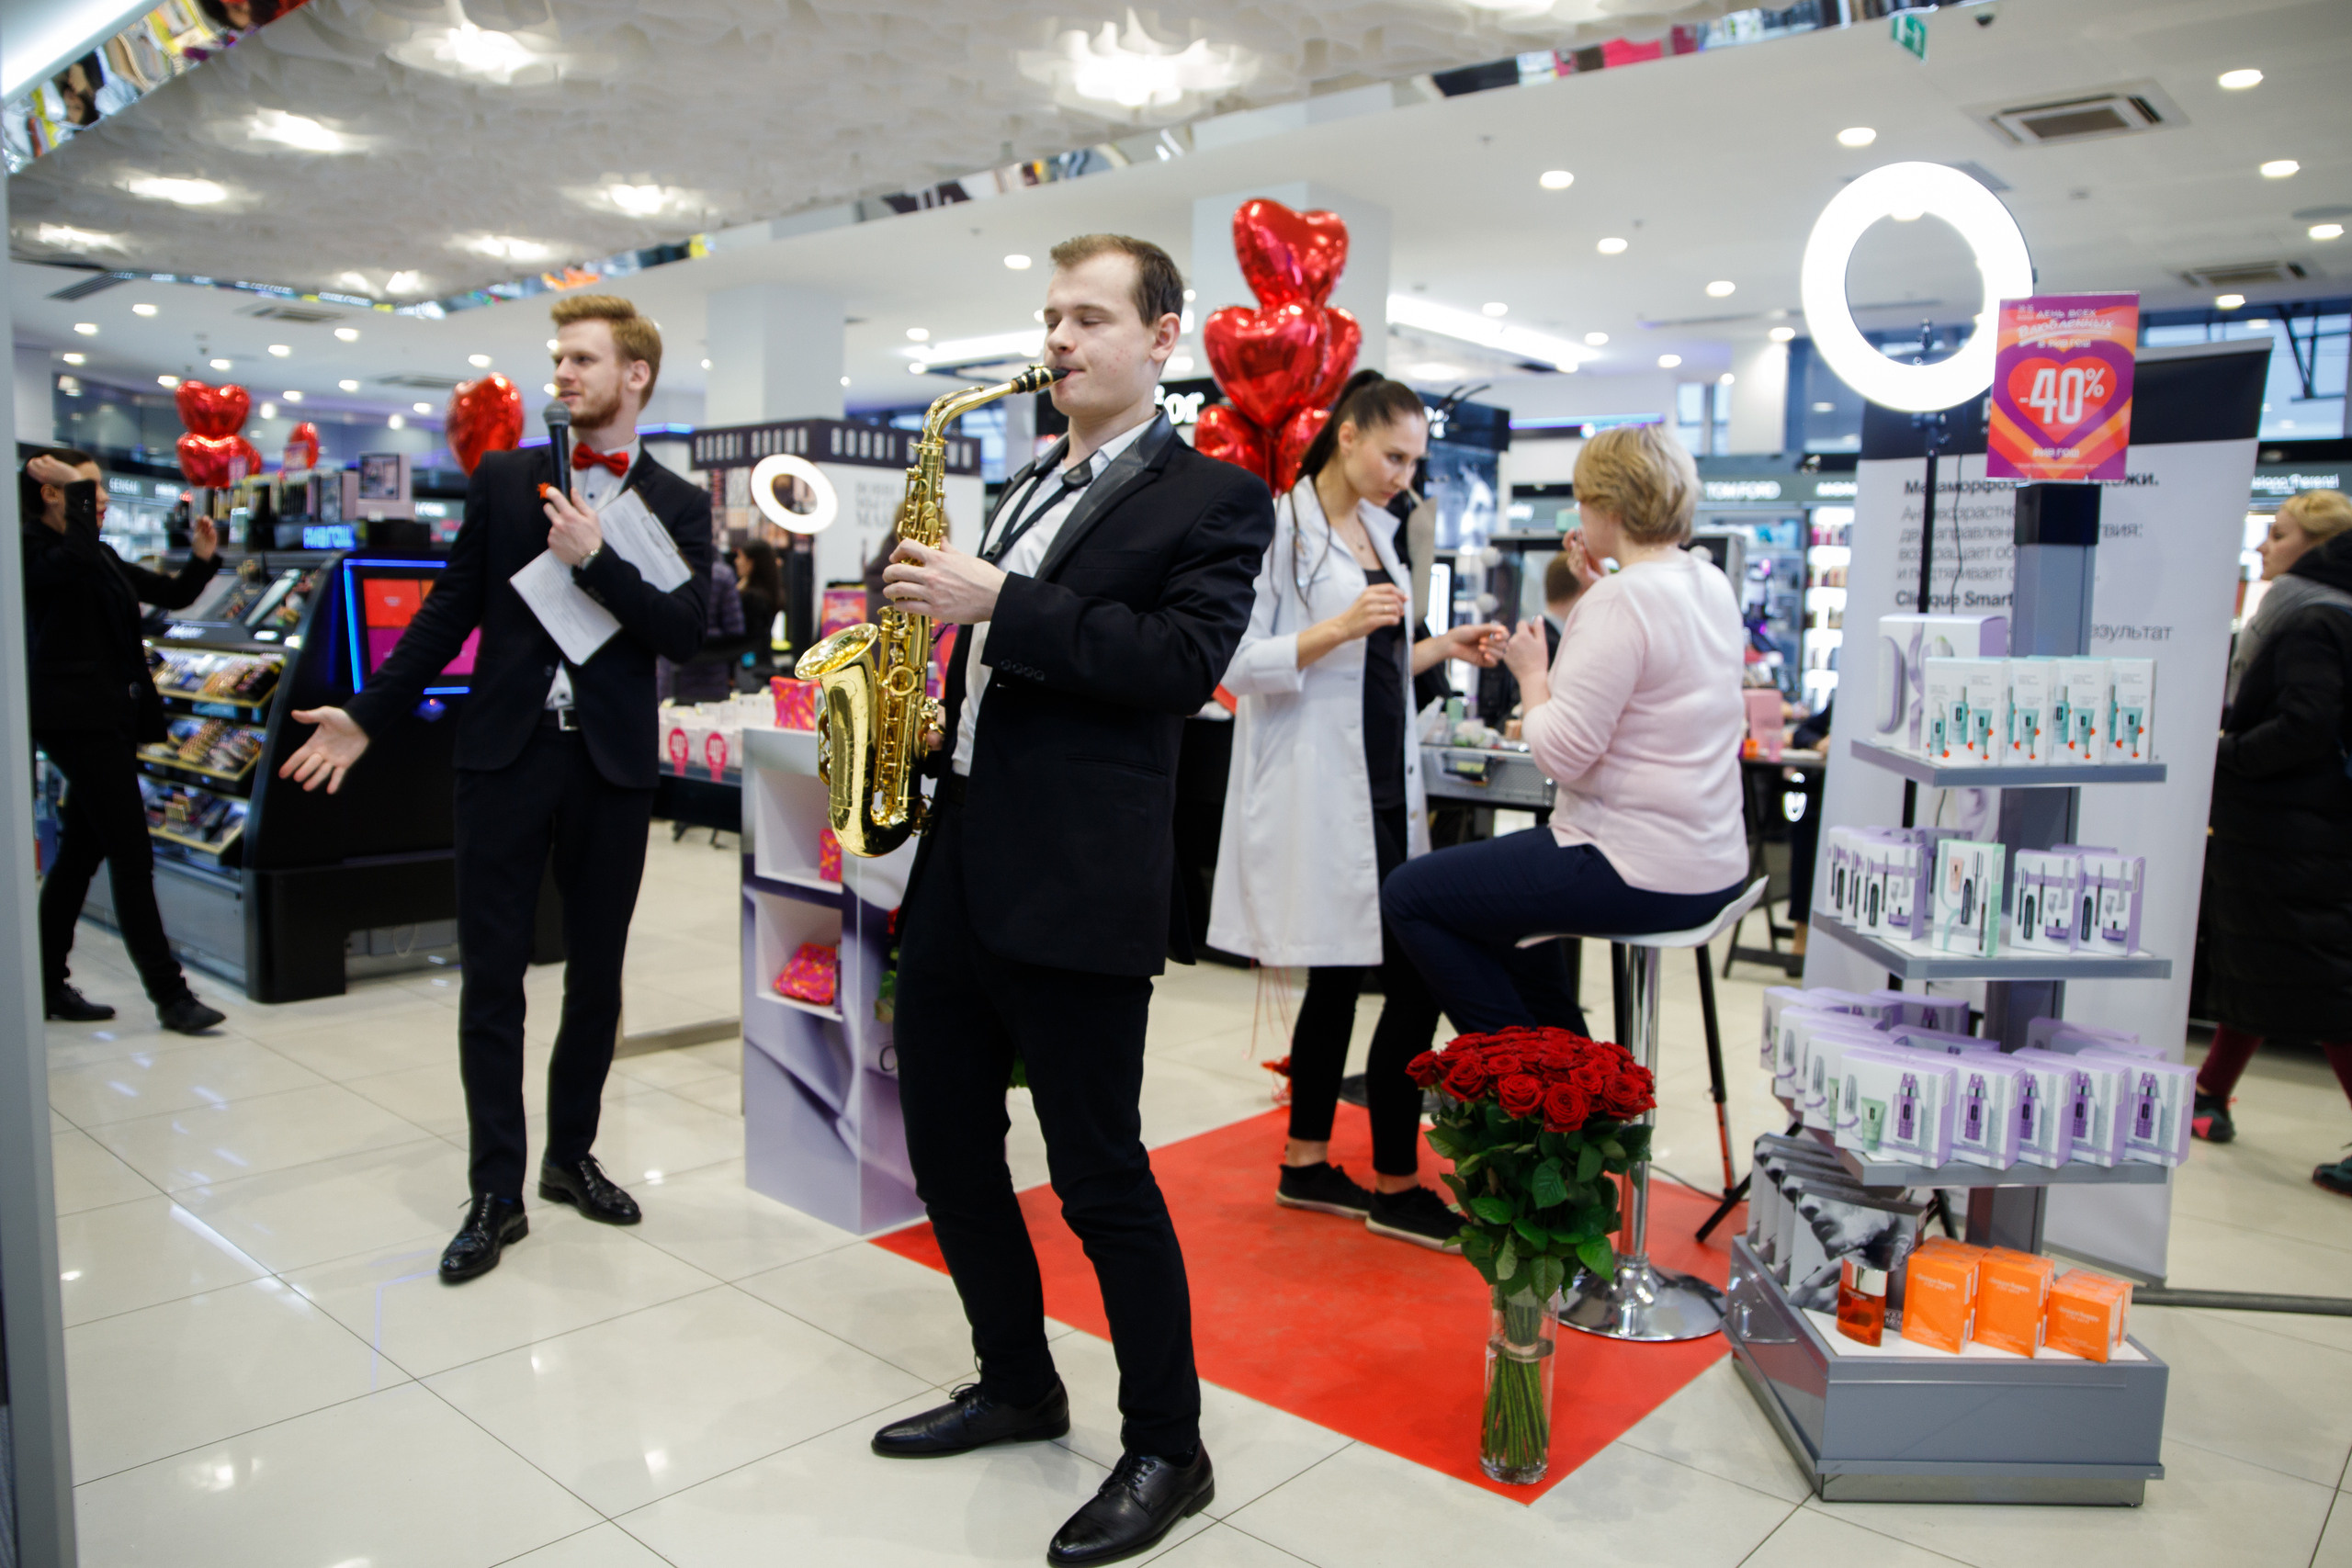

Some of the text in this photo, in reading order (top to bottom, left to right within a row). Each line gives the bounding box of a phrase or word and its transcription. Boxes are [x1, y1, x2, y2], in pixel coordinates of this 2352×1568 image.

[2036, 310, 2065, 320] ДЕНЬ
[2068, 309, 2097, 318] ВСЕХ
[2018, 367, 2106, 424] -40%
